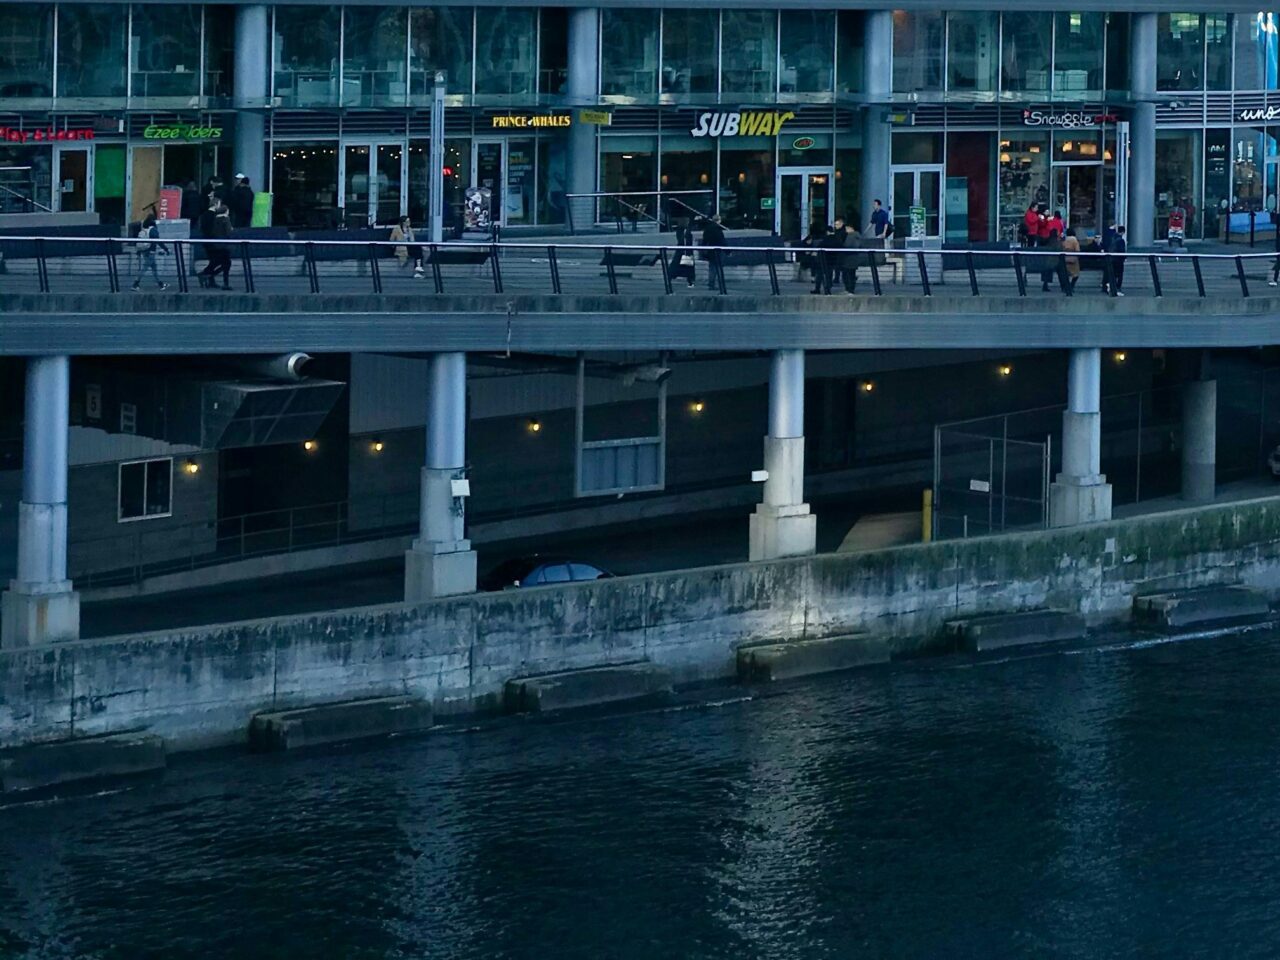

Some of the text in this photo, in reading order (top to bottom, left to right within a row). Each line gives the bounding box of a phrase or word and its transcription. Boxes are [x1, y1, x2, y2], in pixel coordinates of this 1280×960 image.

[493, 116, 528, 127] PRINCE
[532, 115, 571, 127] WHALES
[691, 111, 795, 137] SUBWAY
[1024, 111, 1094, 128] Snowggle
